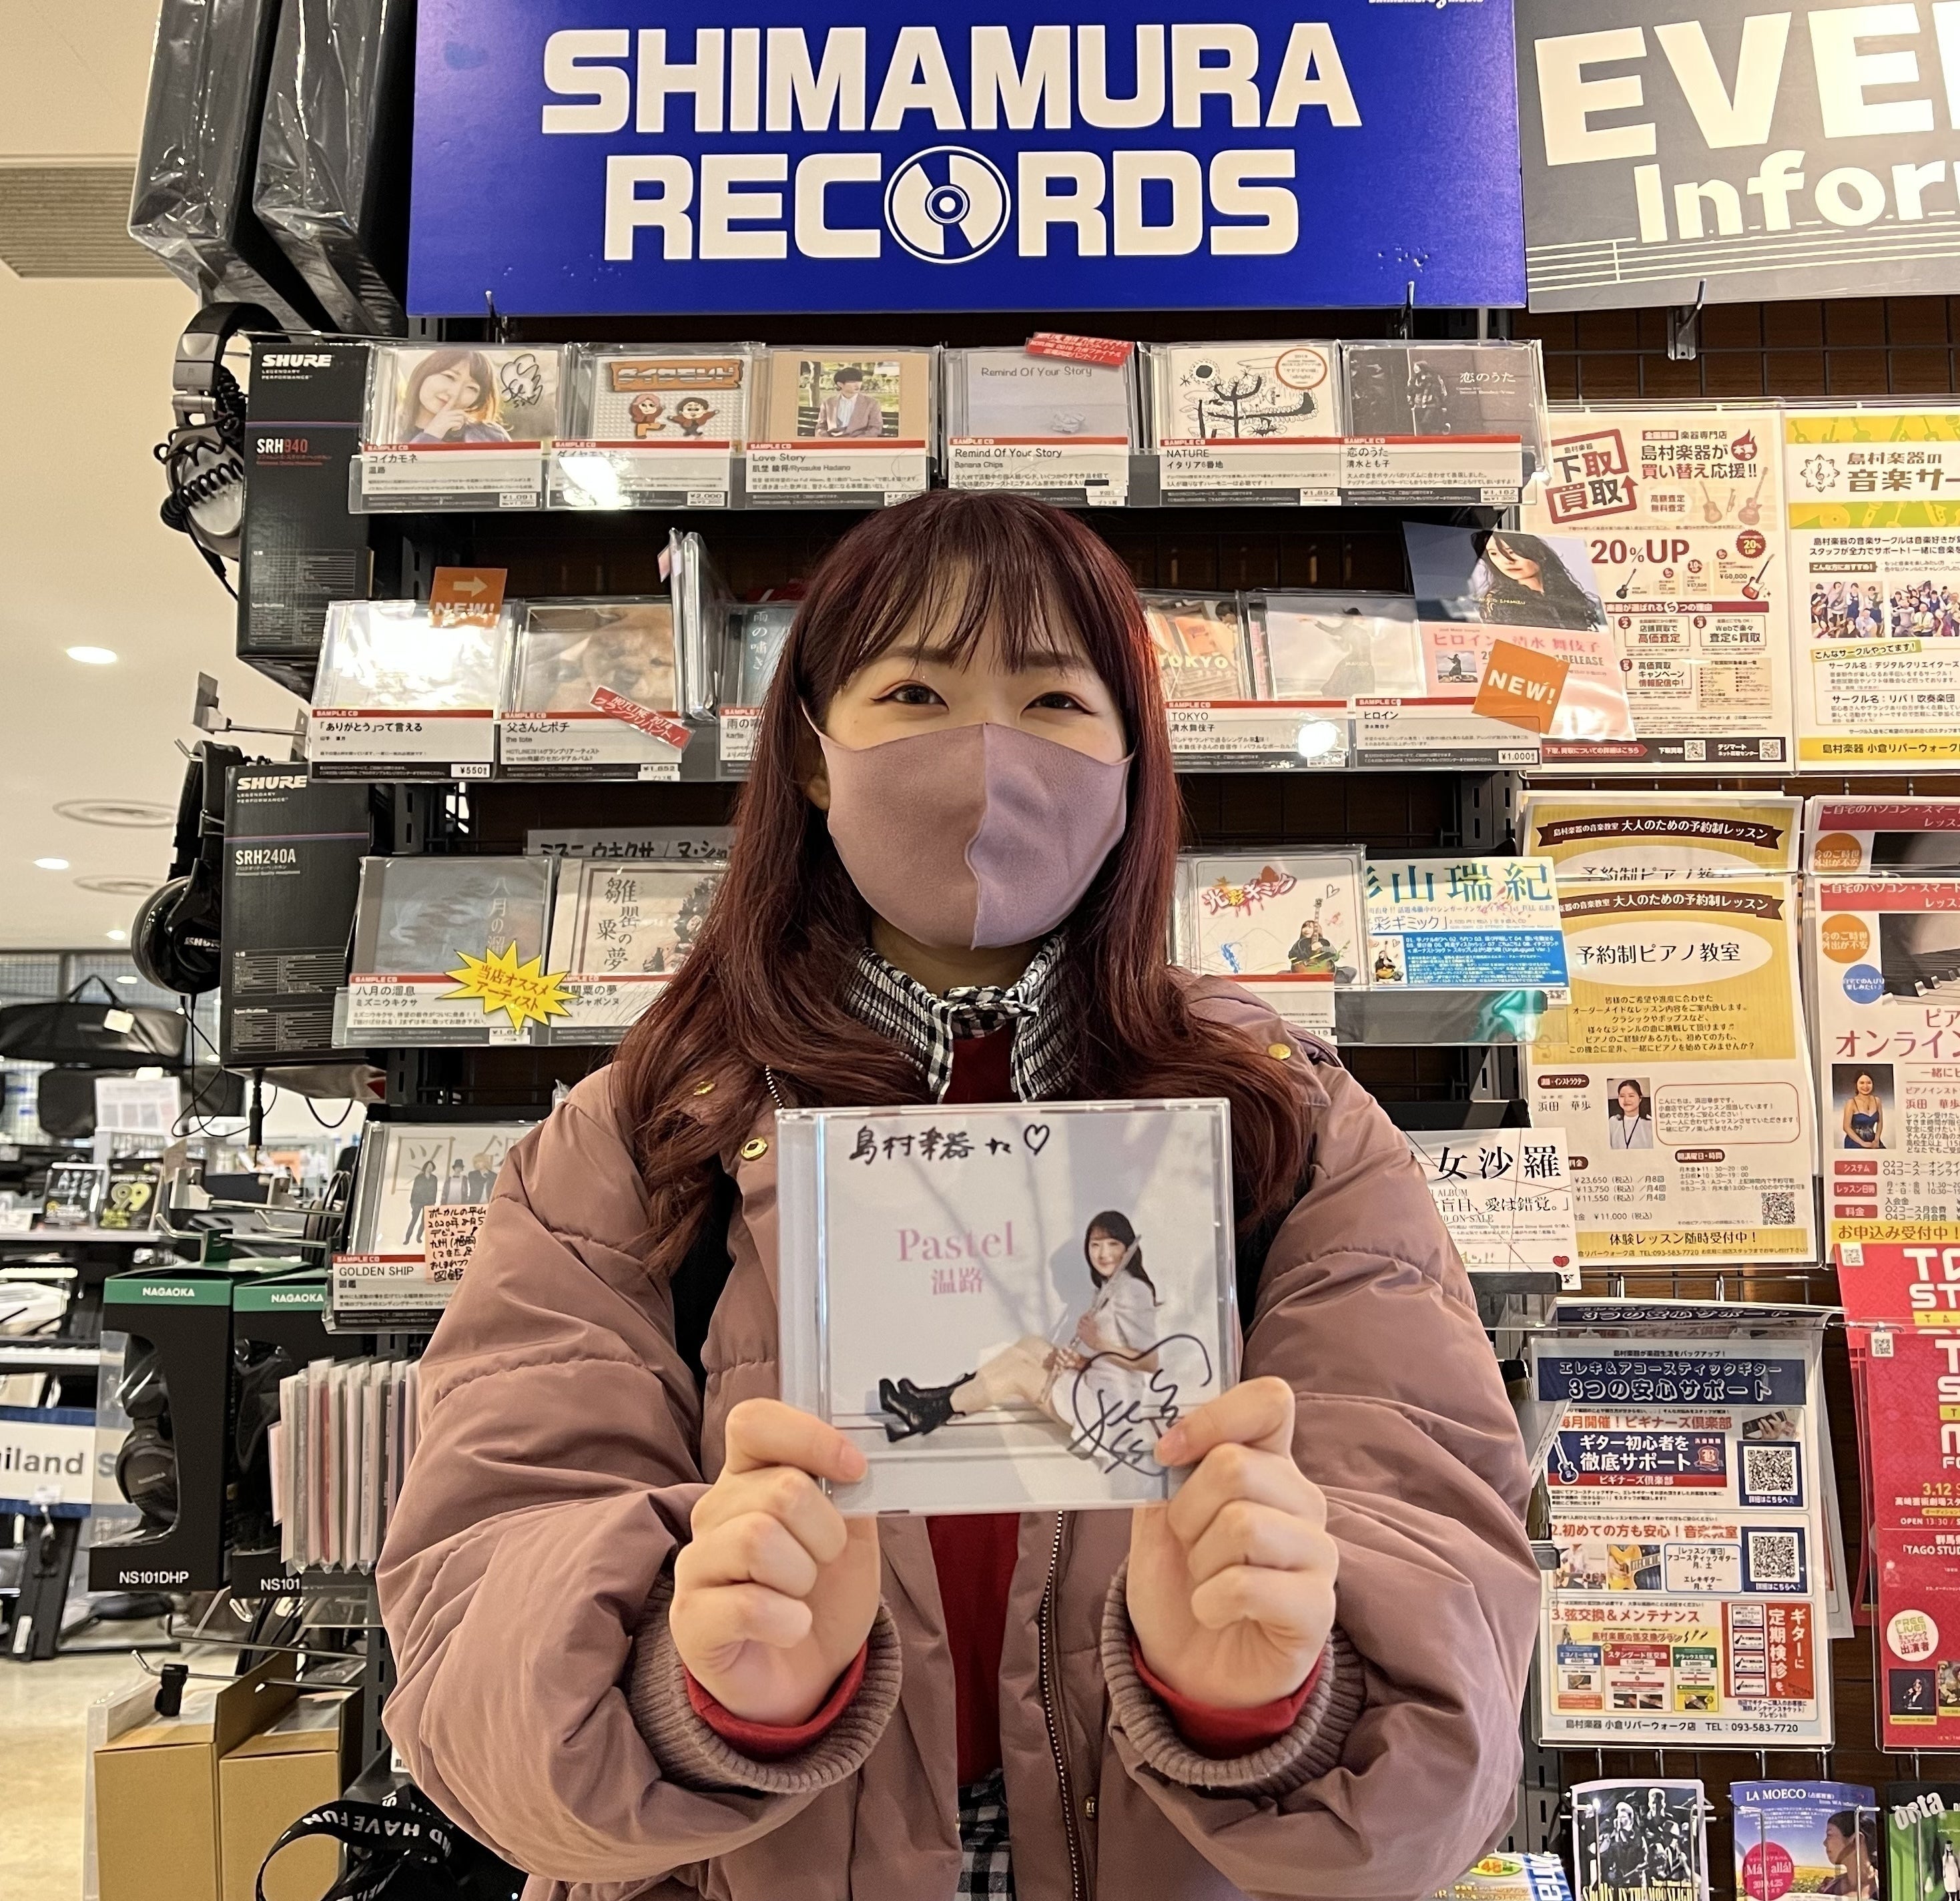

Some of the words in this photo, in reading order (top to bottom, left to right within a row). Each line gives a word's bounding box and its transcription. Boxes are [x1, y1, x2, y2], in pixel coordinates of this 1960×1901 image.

[542, 22, 1362, 133] SHIMAMURA
[1534, 0, 1960, 166] EVE
[1634, 150, 1960, 243] Infor
[604, 146, 1299, 264] RECORDS
[262, 354, 332, 368] SHURE
[981, 367, 1017, 377] Remind
[1020, 367, 1035, 376] Of
[1038, 367, 1060, 376] Your
[1064, 366, 1092, 378] Story
[1459, 372, 1516, 383] 恋のうた
[1680, 431, 1727, 440] 楽器専門店
[257, 438, 308, 454] SRH940
[1347, 447, 1389, 458] 恋のうた
[1641, 445, 1728, 461] 島村楽器が
[369, 453, 418, 464] コイカモネ
[752, 453, 776, 462] Love
[779, 453, 806, 463] Story
[955, 449, 990, 458] Remind
[994, 449, 1006, 457] Of
[1010, 449, 1032, 458] Your
[1036, 448, 1062, 459] Story
[1167, 449, 1210, 458] NATURE
[1847, 451, 1942, 465] 島村楽器の
[1347, 460, 1390, 468] 清水とも子
[1553, 451, 1612, 483] 下取
[1558, 479, 1623, 513] 買取
[1650, 505, 1685, 513] 無料査定
[1590, 539, 1690, 563] 20%UP
[434, 601, 496, 616] NEW!
[1638, 661, 1672, 669] 高価買取
[1488, 669, 1556, 705] NEW!
[611, 696, 647, 718] HOTLINE
[1173, 712, 1209, 721] TOKYO
[1364, 711, 1399, 720] ヒロイン
[320, 722, 423, 732] 「ありがとう」って言える
[507, 722, 570, 733] 父さんとポチ
[1823, 744, 1864, 754] 島村楽器
[1867, 742, 1960, 753] 小倉リバーウォーク
[1502, 752, 1530, 761] ¥1,000
[460, 766, 482, 774] ¥550
[237, 775, 308, 790] SHURE
[1823, 804, 1960, 814] ご自宅のパソコン・スマー
[1621, 819, 1768, 840] 大人のための予約制レッスン
[235, 848, 296, 865] SRH240A
[1613, 893, 1769, 911] 大人のための予約制レッスン
[1822, 931, 1868, 941] 今のご時世
[1576, 942, 1741, 966] 予約制ピアノ教室
[478, 964, 549, 996] 当店オススメ
[356, 999, 418, 1007] ミズニウキクサ
[475, 980, 539, 1013] アーティスト
[1836, 1030, 1960, 1059] オンライ
[848, 1126, 976, 1165] 島村楽器
[1433, 1145, 1562, 1181] 女沙羅
[1843, 1164, 1870, 1172] システム
[1437, 1188, 1468, 1197] ALBUM
[1452, 1214, 1466, 1223] ON
[1469, 1214, 1494, 1223] SALE
[1845, 1206, 1865, 1217] 料金
[1609, 1232, 1756, 1246] 体験レッスン随時受付中！
[1838, 1225, 1958, 1241] お申込み受付中！
[896, 1220, 1015, 1263] Pastel
[339, 1266, 385, 1276] GOLDEN
[388, 1265, 414, 1276] SHIP
[930, 1268, 984, 1296] 温路
[142, 1286, 195, 1298] NAGAOKA
[270, 1293, 324, 1303] NAGAOKA
[1568, 1378, 1772, 1401] 3つの安心サポート
[1580, 1434, 1689, 1452] ギター初心者を
[0, 1451, 83, 1475] iland
[1580, 1452, 1692, 1472] 徹底サポート
[1599, 1475, 1674, 1486] ビギナーズ倶楽部
[1922, 1482, 1952, 1496] 3.12
[1900, 1517, 1923, 1525] OPEN
[119, 1571, 190, 1585] NS101DHP
[1895, 1616, 1925, 1626] FREE
[1790, 1607, 1807, 1669] ギターに
[1566, 1719, 1602, 1729] 島村楽器
[1604, 1720, 1696, 1731] 小倉リバーウォーク店
[1746, 1791, 1760, 1801] LA
[1762, 1788, 1807, 1800] MOECO
[353, 1815, 420, 1837] HAVE
